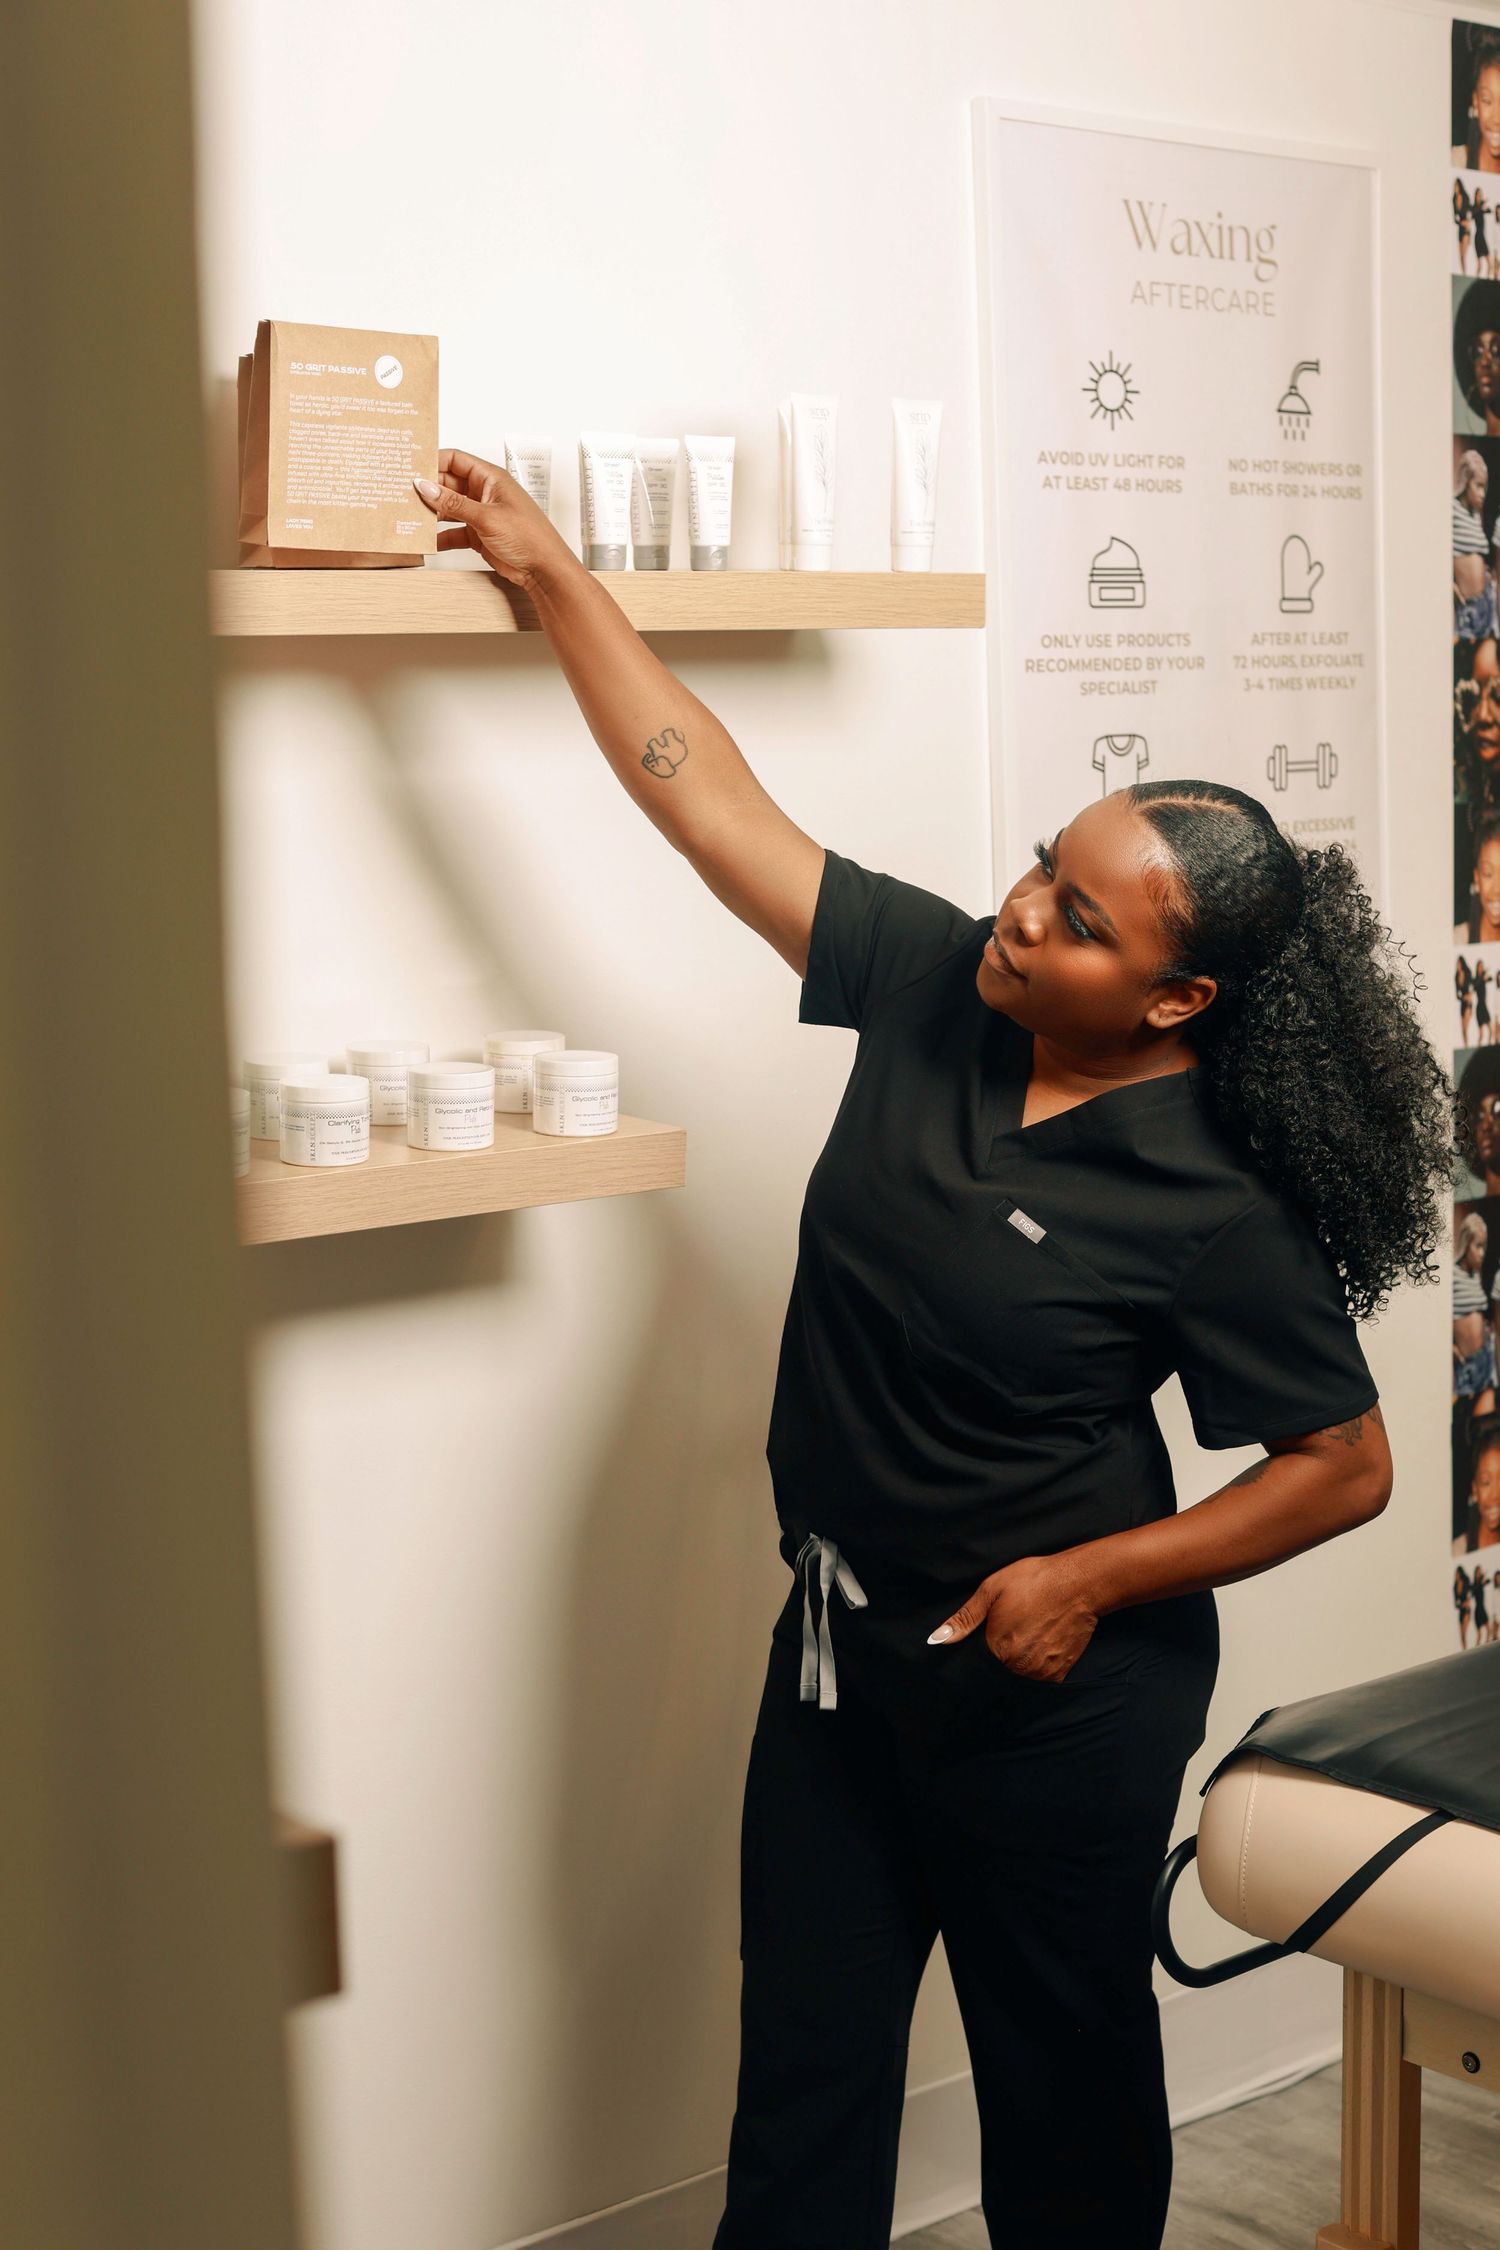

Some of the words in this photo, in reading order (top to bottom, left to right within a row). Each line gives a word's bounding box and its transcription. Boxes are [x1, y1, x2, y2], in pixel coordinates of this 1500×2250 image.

[1122, 198, 1278, 283] Waxing
[1130, 280, 1276, 317] AFTERCARE
[305, 363, 327, 372] GRIT
[328, 365, 367, 375] PASSIVE
[1037, 450, 1084, 466] AVOID
[1087, 452, 1109, 467] UV
[1113, 453, 1154, 468] LIGHT
[1158, 454, 1185, 469] FOR
[1228, 458, 1248, 473] NO
[1251, 459, 1278, 473] HOT
[1281, 459, 1343, 476] SHOWERS
[1345, 462, 1362, 477] OR
[1041, 474, 1062, 490] AT
[1066, 475, 1108, 491] LEAST
[1113, 476, 1131, 491] 48
[1135, 477, 1183, 493] HOURS
[1229, 481, 1273, 496] BATHS
[1276, 482, 1299, 497] FOR
[1301, 483, 1317, 498] 24
[1321, 485, 1362, 500] HOURS
[1040, 633, 1081, 648] ONLY
[1085, 633, 1112, 648] USE
[1116, 632, 1191, 648] PRODUCTS
[1250, 631, 1291, 646] AFTER
[1293, 631, 1307, 645] AT
[1311, 631, 1349, 645] LEAST
[1025, 656, 1143, 672] RECOMMENDED
[1146, 656, 1164, 670] BY
[1166, 655, 1205, 670] YOUR
[1232, 654, 1247, 669] 72
[1300, 653, 1363, 668] EXFOLIATE
[1080, 679, 1157, 695] SPECIALIST
[1243, 677, 1263, 691] 3-4
[1267, 676, 1303, 690] TIMES
[1305, 675, 1356, 690] WEEKLY
[1293, 817, 1355, 832] EXCESSIVE
[435, 1107, 463, 1115] Glycolic
[328, 1119, 360, 1127] Clarifying
[1019, 1218, 1035, 1234] FIGS
